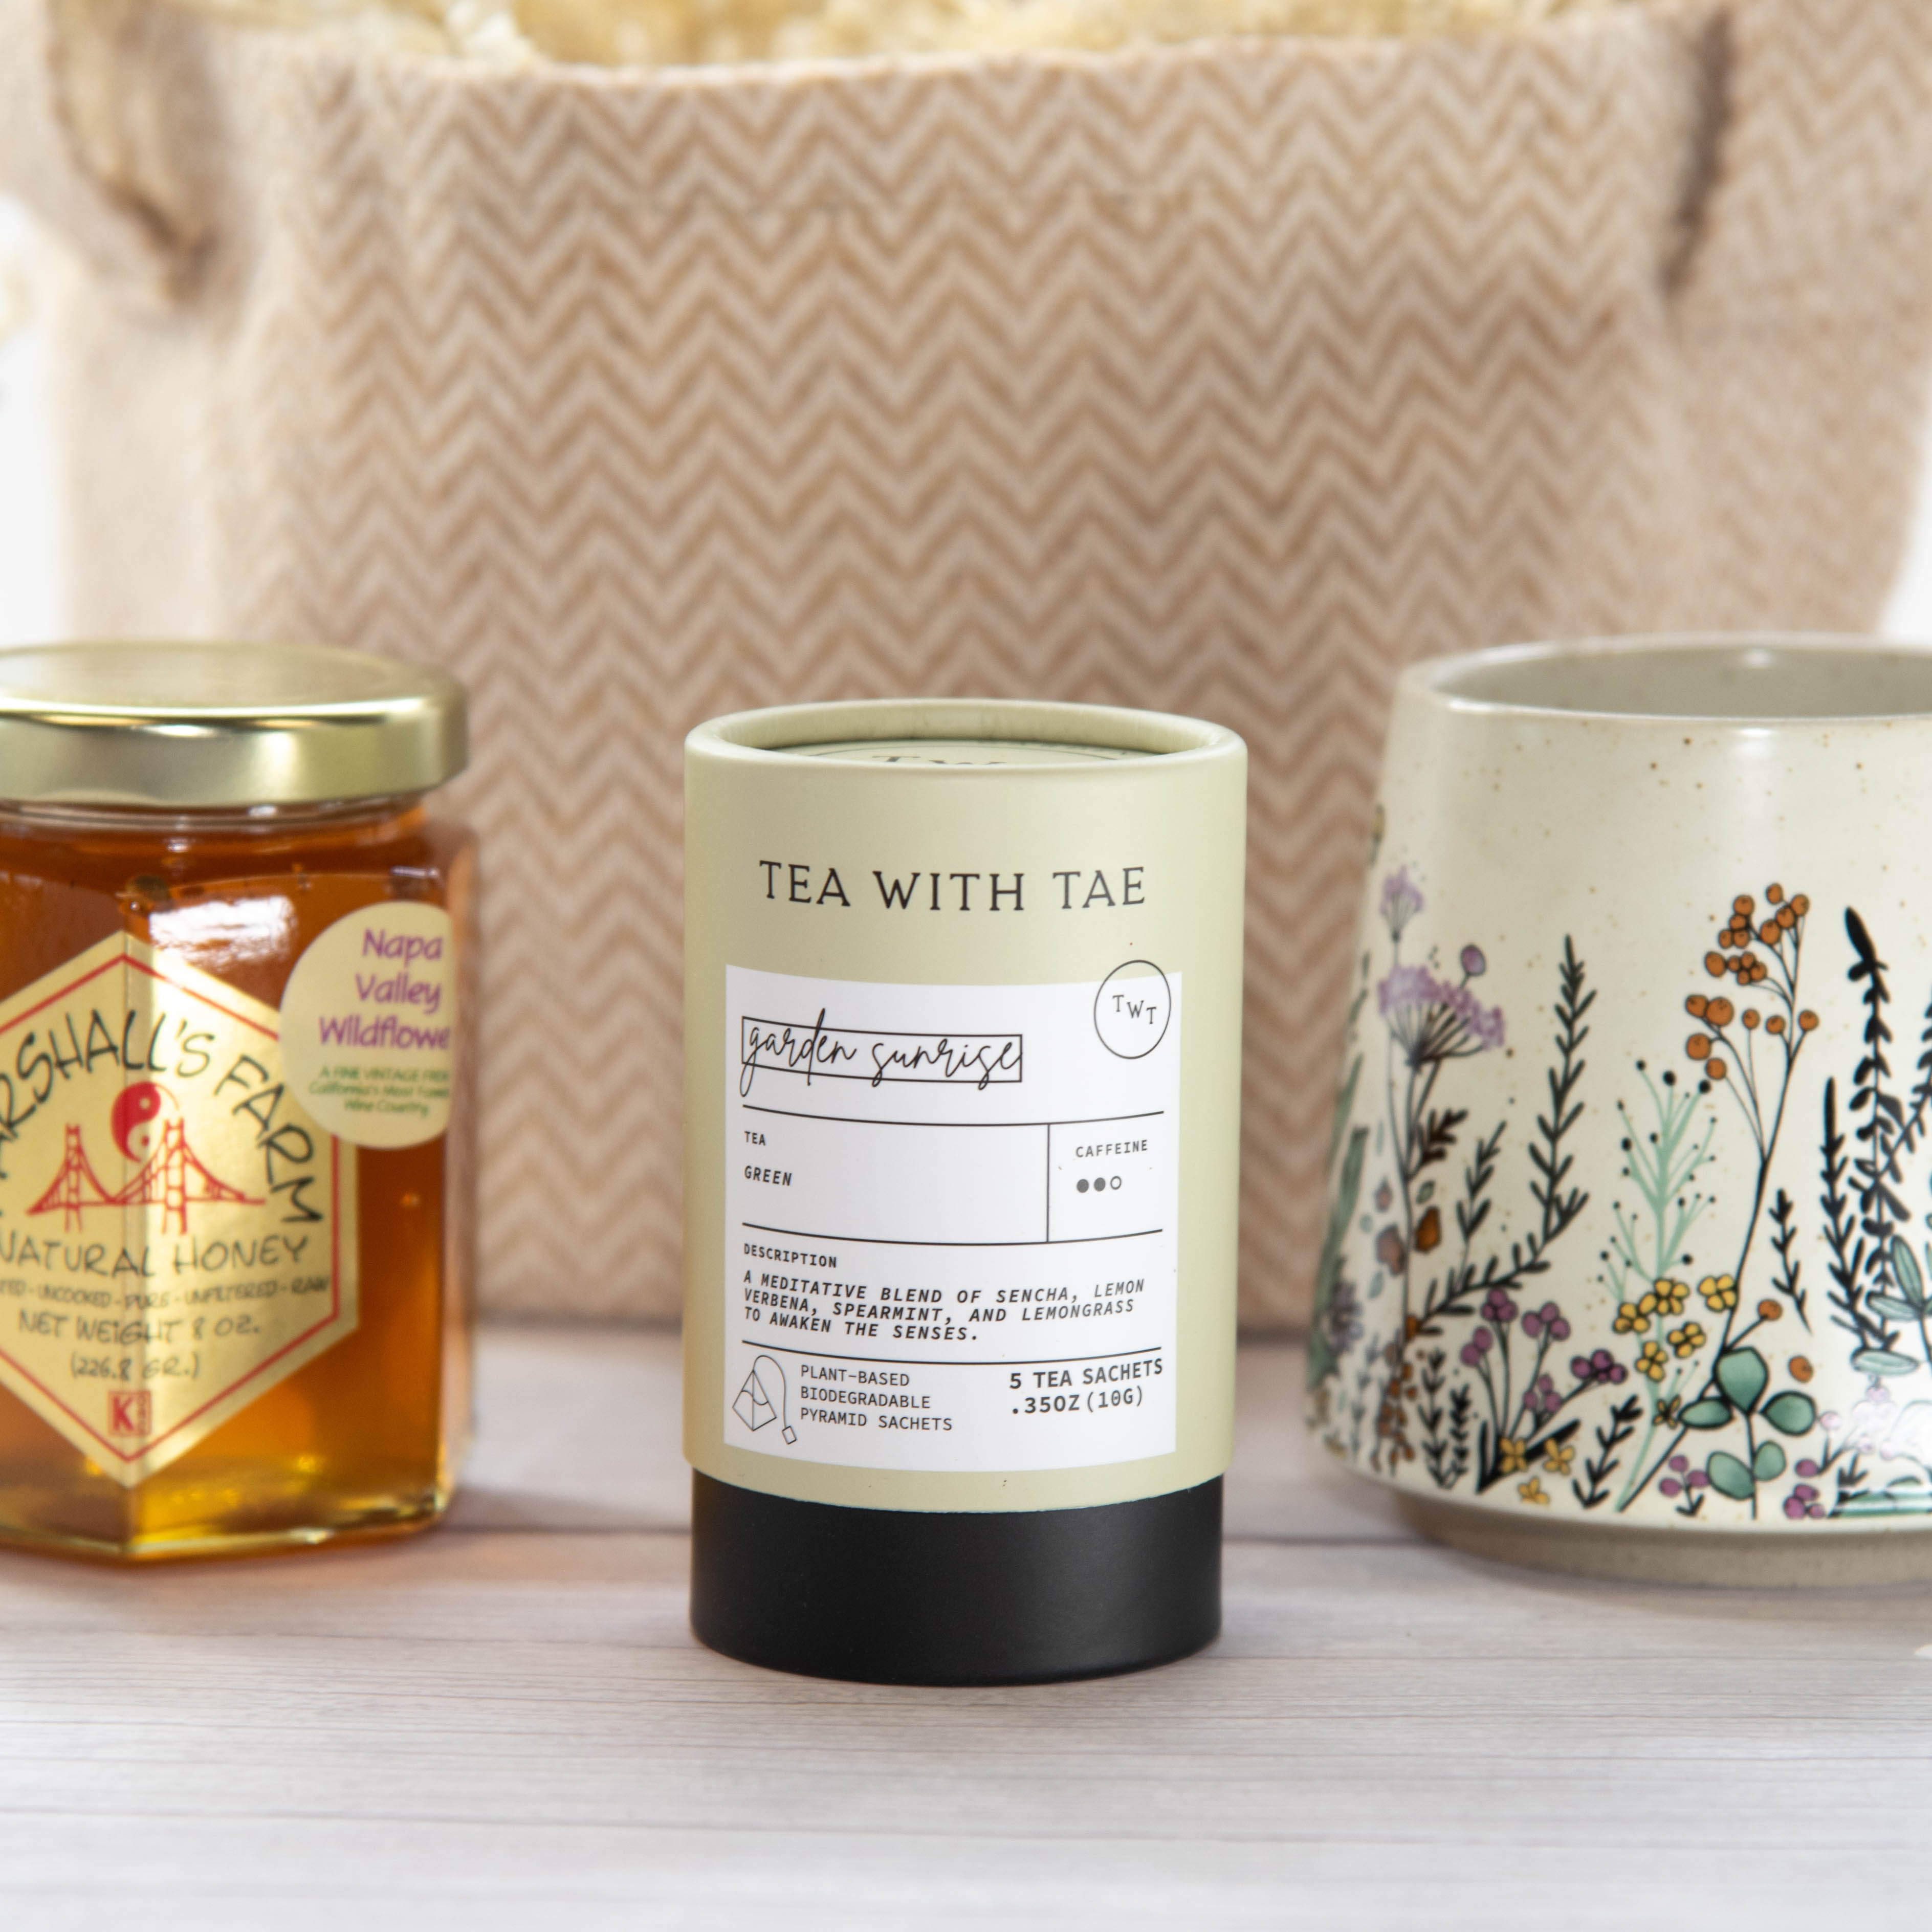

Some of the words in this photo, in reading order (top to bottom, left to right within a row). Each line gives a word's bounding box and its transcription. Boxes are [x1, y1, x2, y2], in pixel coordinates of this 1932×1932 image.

[759, 860, 851, 907] TEA
[872, 870, 1025, 912] WITH
[1052, 866, 1145, 910] TAE
[362, 928, 444, 969] Napa
[355, 972, 442, 1016] Valley
[1112, 994, 1157, 1025] TWT
[740, 1008, 857, 1097] garden
[871, 1038, 1022, 1090] sunrise
[744, 1130, 766, 1146] TEA
[1075, 1139, 1148, 1158] CAFFEINE
[744, 1165, 793, 1187] GREEN
[173, 1234, 308, 1275] HONEY
[743, 1243, 837, 1268] DESCRIPTION
[743, 1269, 752, 1284] A
[760, 1273, 867, 1300] MEDITATIVE
[880, 1287, 942, 1303] BLEND
[956, 1289, 982, 1304] OF
[996, 1287, 1077, 1304] SENCHA,
[1094, 1279, 1145, 1298] LEMON
[19, 1308, 69, 1337] NET
[744, 1288, 819, 1316] VERBENA,
[832, 1302, 952, 1326] SPEARMINT,
[968, 1308, 1007, 1322] AND
[1021, 1298, 1134, 1321] LEMONGRASS
[744, 1306, 761, 1322] TO
[769, 1311, 832, 1333] AWAKEN
[844, 1321, 879, 1337] THE
[892, 1324, 977, 1341] SENSES.
[801, 1364, 910, 1387] PLANT-BASED
[1009, 1372, 1022, 1390] 5
[1033, 1370, 1072, 1389] TEA
[1082, 1357, 1163, 1385] SACHETS
[801, 1386, 931, 1409] BIODEGRADABLE
[801, 1407, 867, 1426] PYRAMID
[878, 1415, 953, 1431] SACHETS
